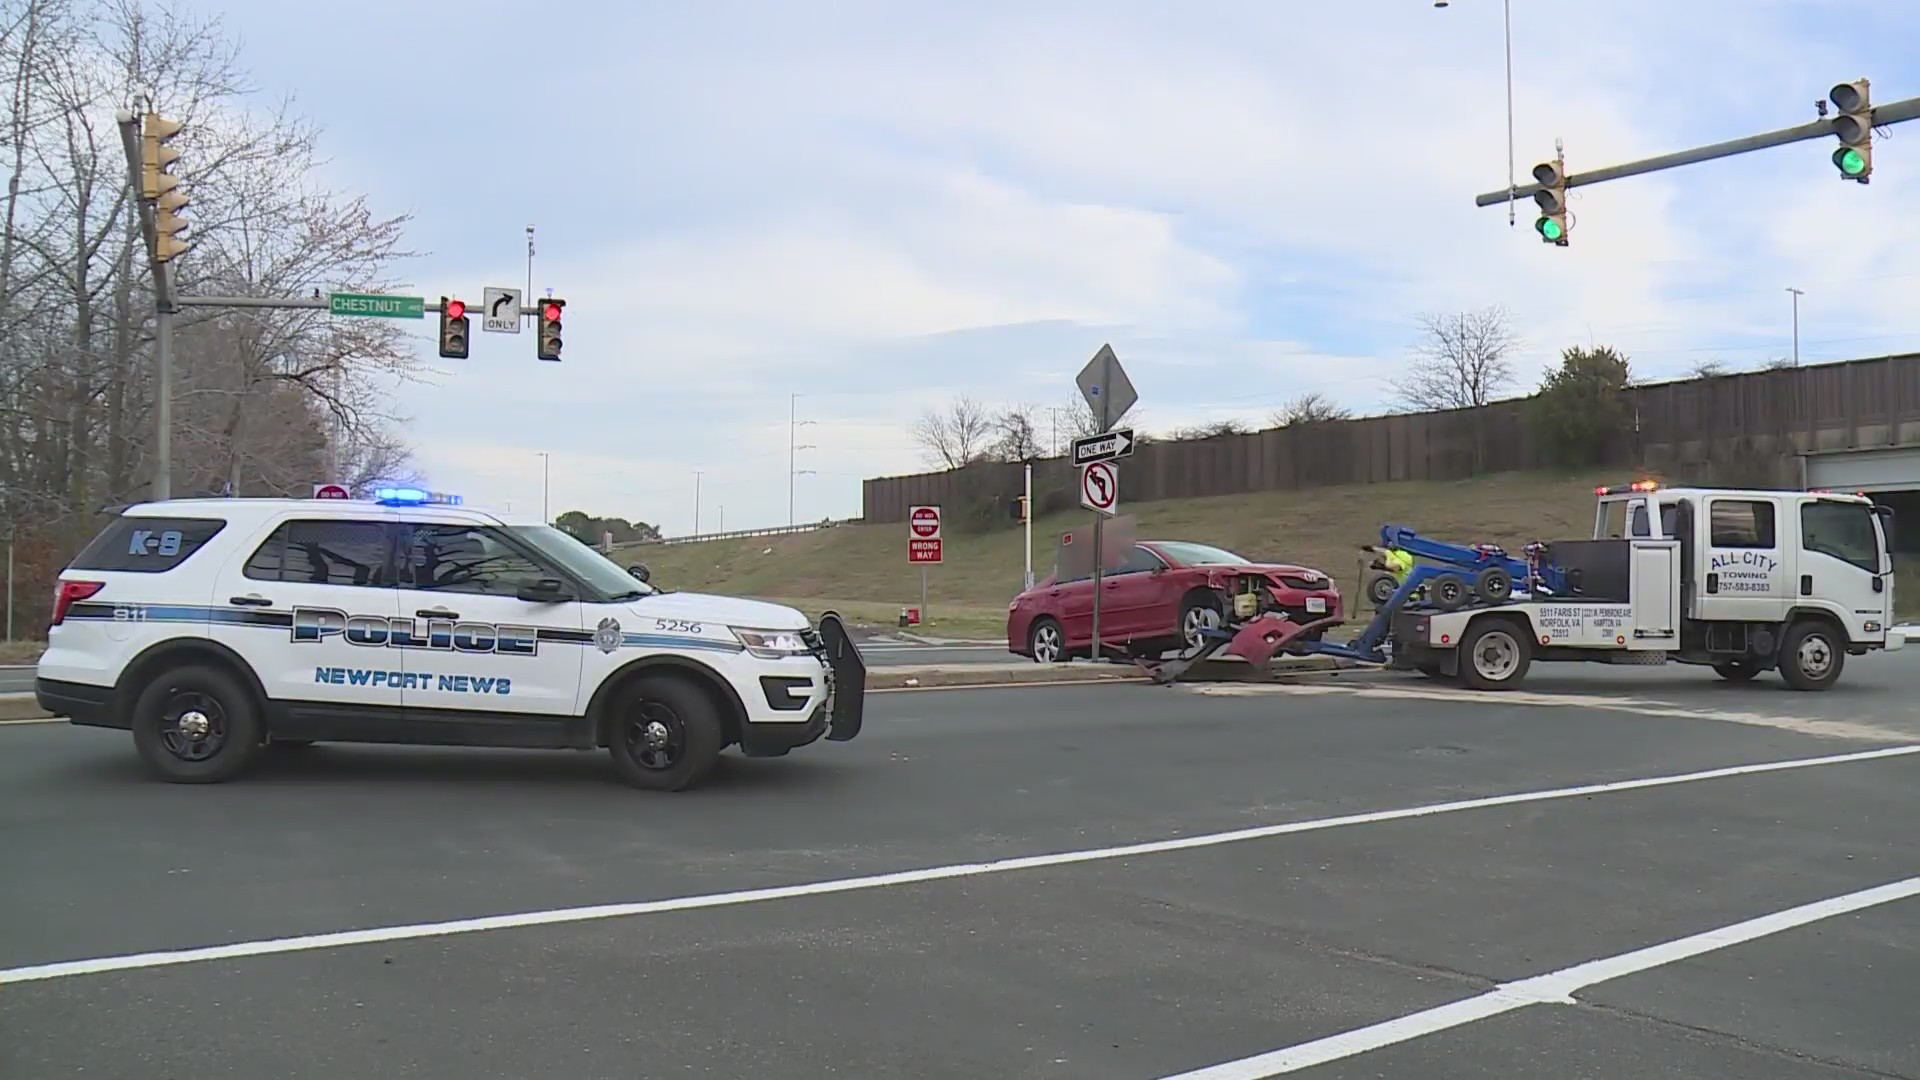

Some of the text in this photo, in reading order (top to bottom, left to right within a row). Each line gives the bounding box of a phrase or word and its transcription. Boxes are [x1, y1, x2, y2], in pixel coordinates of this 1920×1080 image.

[332, 298, 401, 313] CHESTNUT
[487, 319, 515, 329] ONLY
[1080, 440, 1116, 457] ONE WAY
[911, 541, 939, 550] WRONG
[916, 551, 933, 560] WAY
[1711, 551, 1777, 572] ALL CITY
[1719, 582, 1770, 592] 757-583-8383
[113, 608, 147, 622] 911
[1540, 607, 1580, 617] 5511 FARIS ST
[655, 618, 702, 634] 5256
[1571, 619, 1580, 628] VA
[291, 605, 537, 657] POLICE
[1552, 629, 1569, 638] 23513
[314, 666, 511, 695] NEWPORT NEWS
